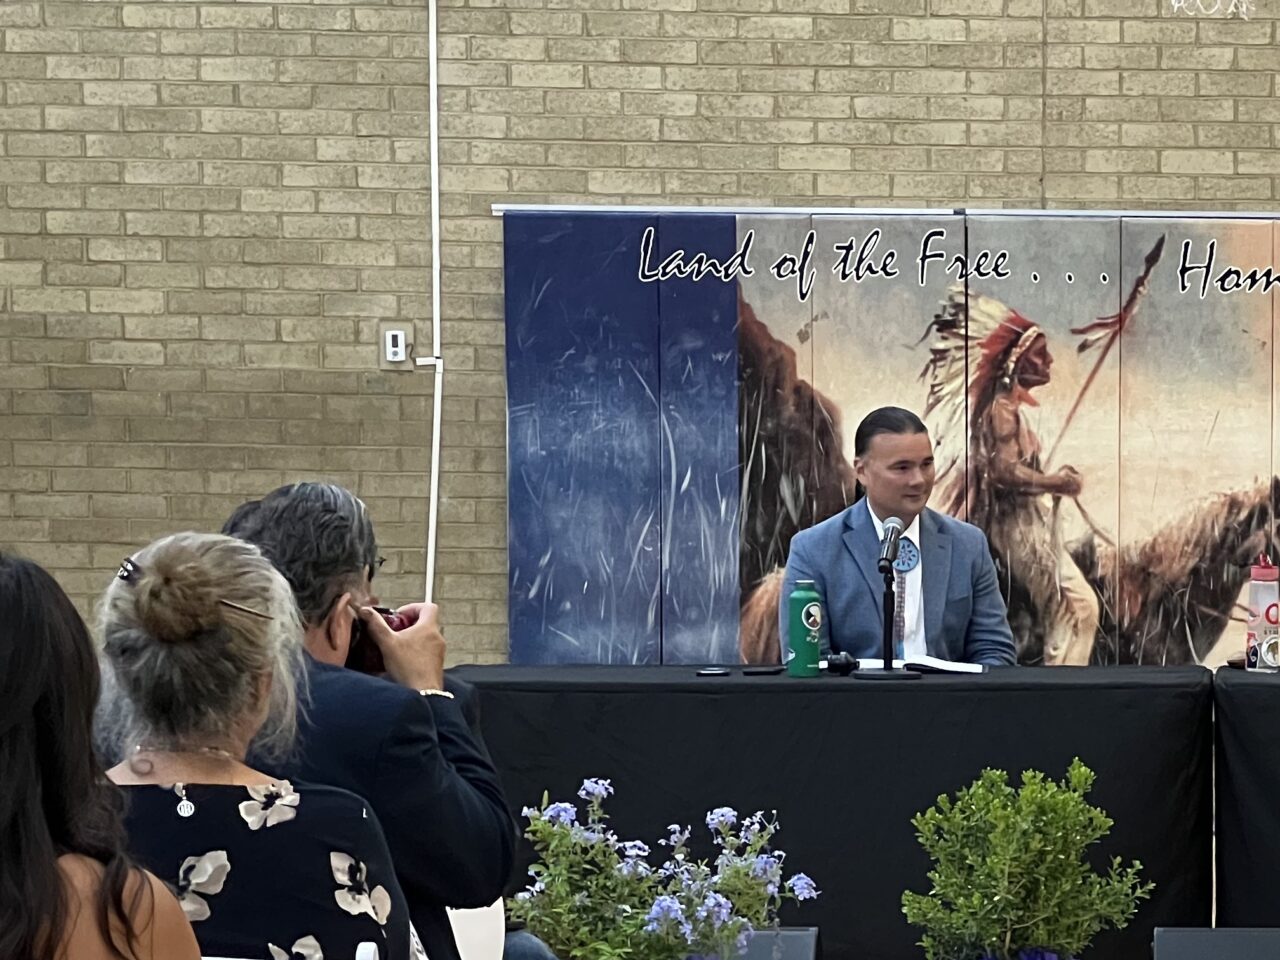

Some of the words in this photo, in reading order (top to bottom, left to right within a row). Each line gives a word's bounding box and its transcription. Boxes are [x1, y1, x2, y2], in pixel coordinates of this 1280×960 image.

[639, 227, 755, 282] Land
[770, 230, 816, 302] of
[832, 228, 899, 283] the
[916, 229, 1011, 286] Free
